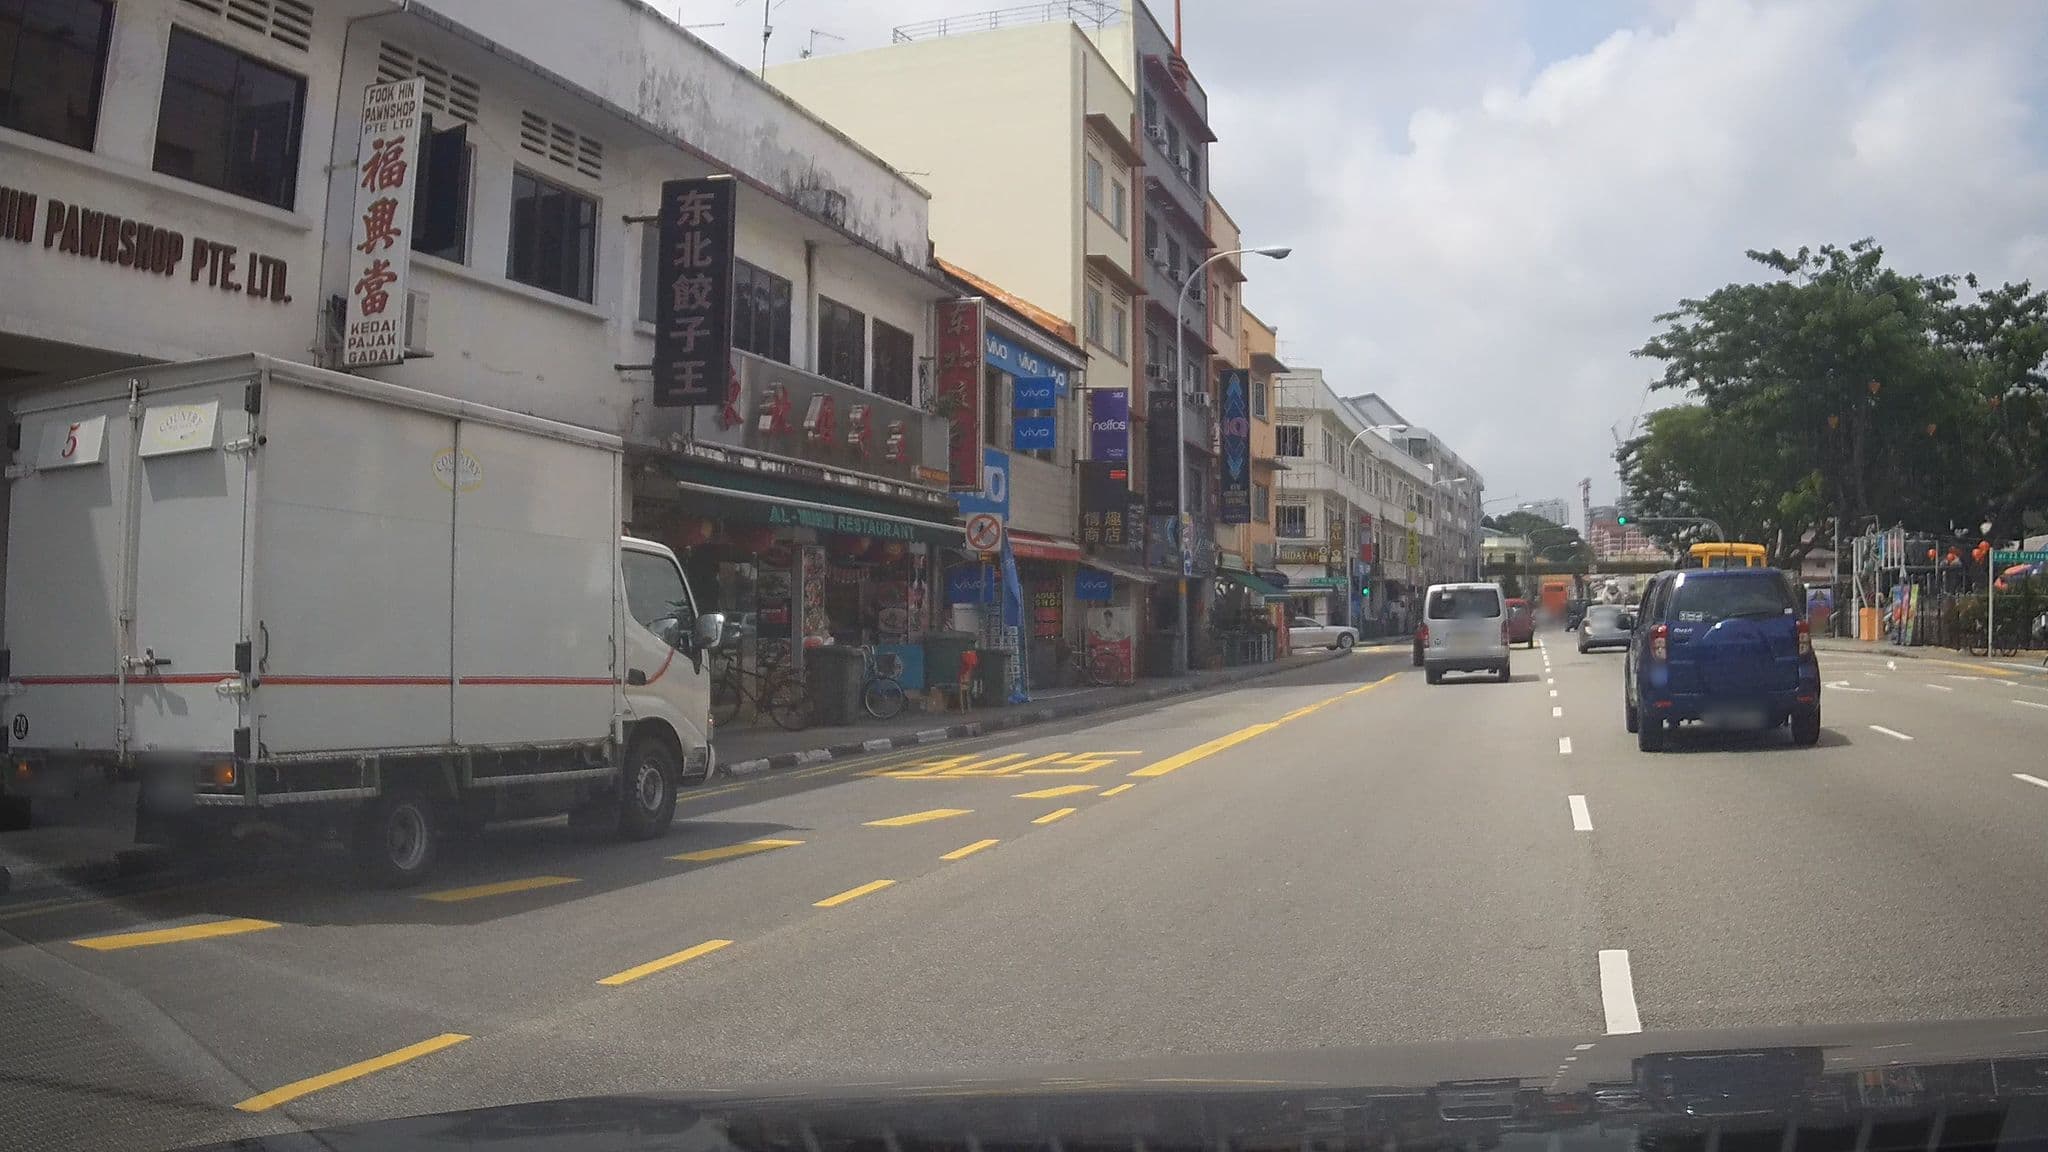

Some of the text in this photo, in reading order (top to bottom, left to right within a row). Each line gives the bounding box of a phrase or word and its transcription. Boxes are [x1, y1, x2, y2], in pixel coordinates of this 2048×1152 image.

[369, 82, 415, 104] FOOK HIN
[365, 101, 416, 123] PAWNSHOP
[365, 118, 413, 135] PTE LTD
[354, 135, 407, 316] 福興當
[44, 198, 184, 276] PAWNSHOP
[190, 237, 242, 291] PTE.
[246, 252, 292, 304] LTD.
[351, 320, 396, 335] KEDAI
[348, 334, 396, 349] PAJAK
[348, 349, 394, 363] GADAI
[1092, 419, 1126, 432] neffos
[61, 422, 81, 458] 5
